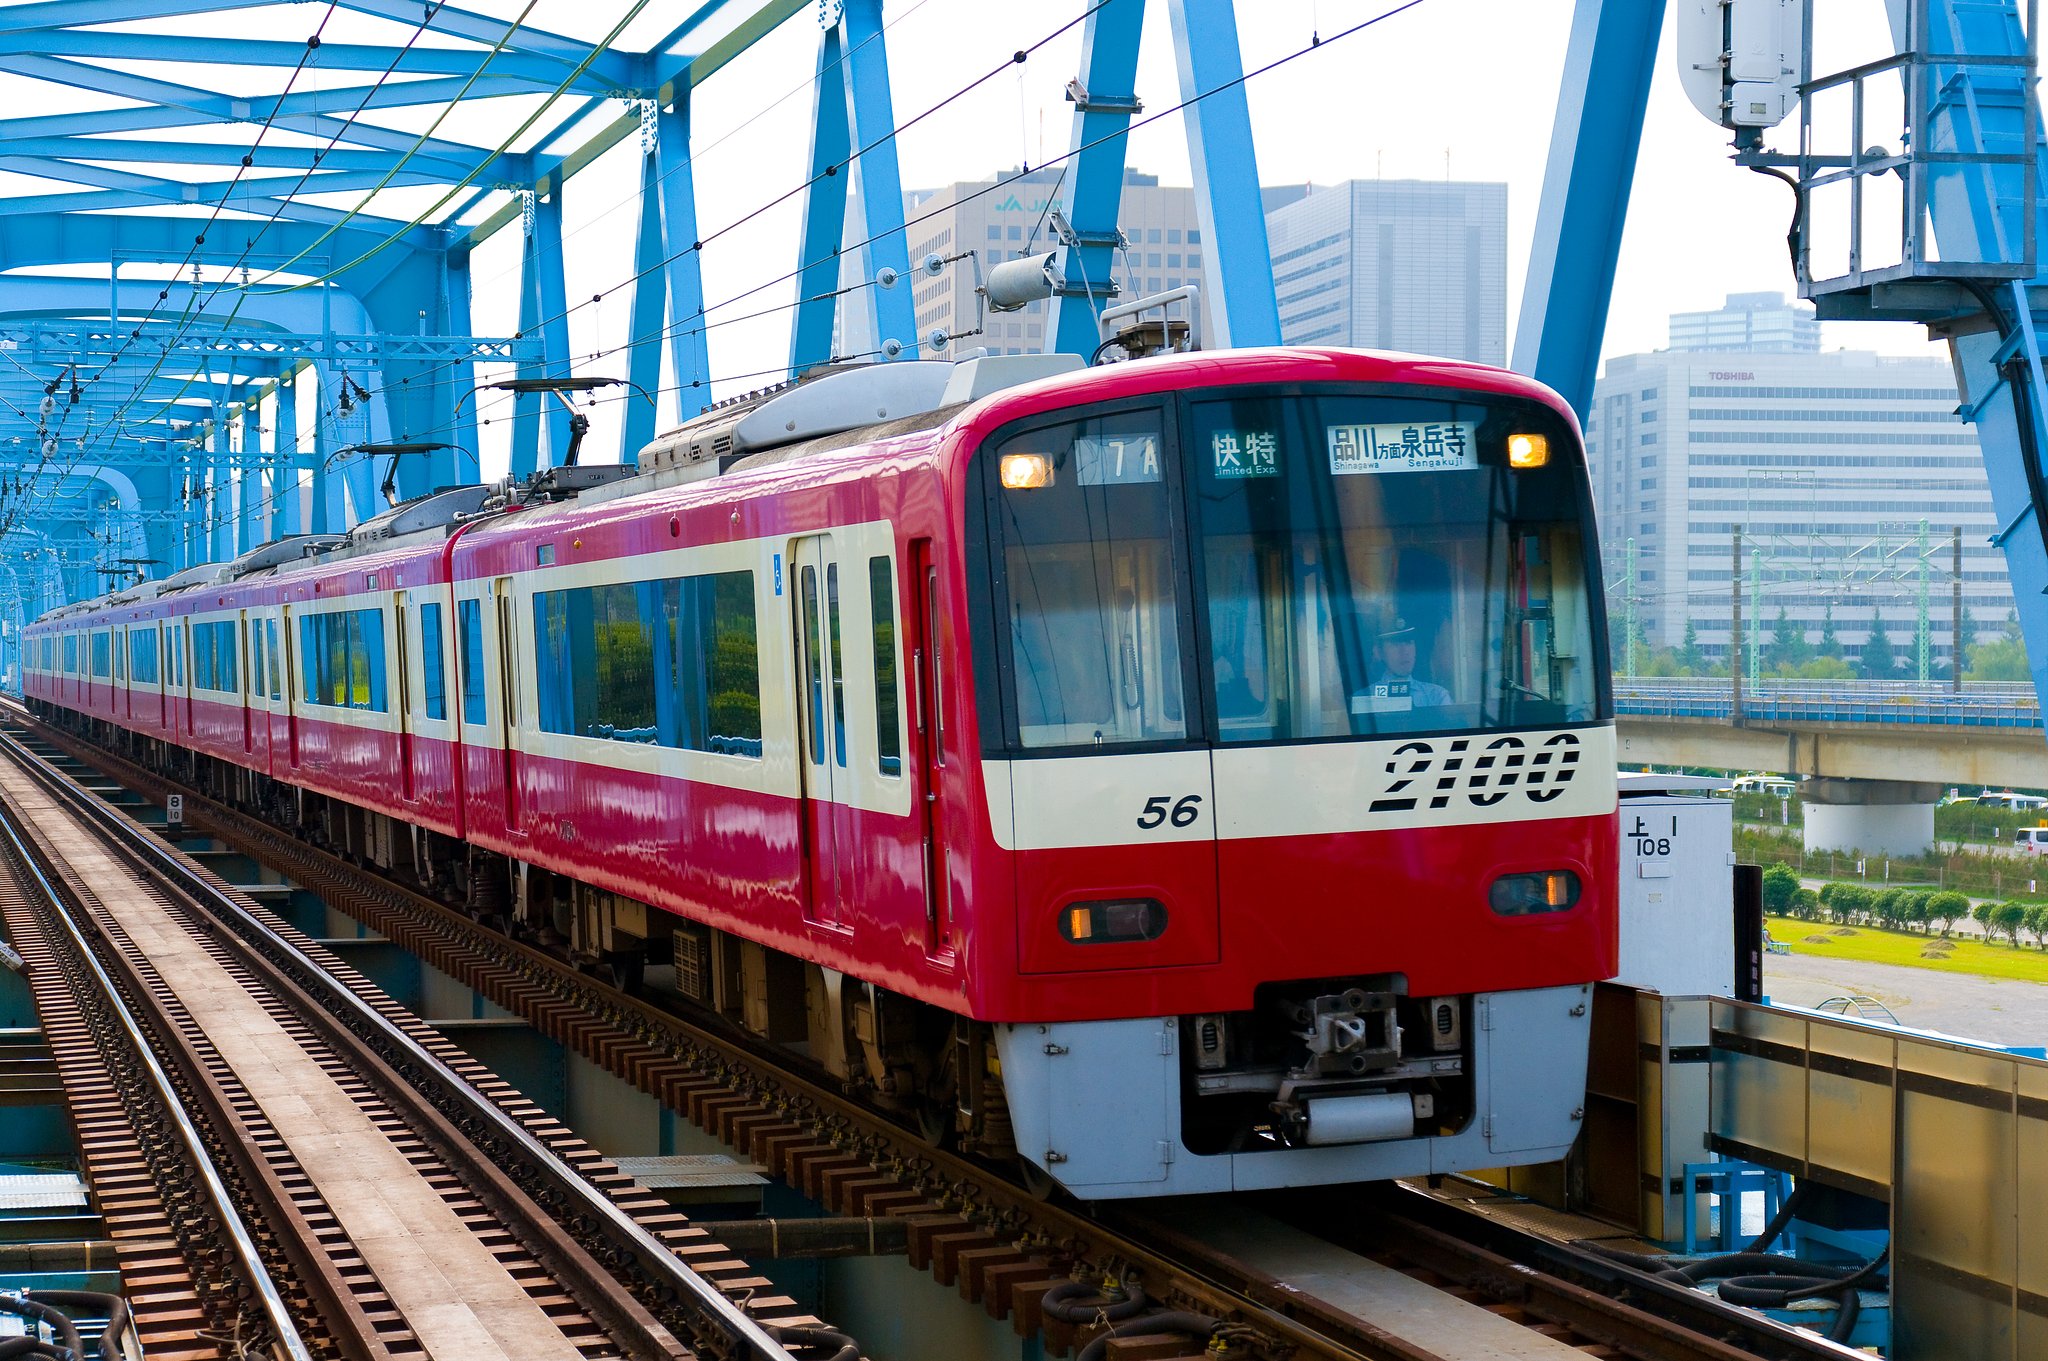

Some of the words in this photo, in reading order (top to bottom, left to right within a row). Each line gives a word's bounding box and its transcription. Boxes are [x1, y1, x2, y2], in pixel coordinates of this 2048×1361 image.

[1708, 371, 1755, 381] TOSHIBA
[1212, 431, 1276, 467] 快特
[1334, 461, 1380, 471] Shinagawa
[1408, 457, 1464, 468] Sengakuji
[1255, 465, 1278, 476] Exp.
[1376, 686, 1387, 697] 12
[1368, 733, 1581, 813] 2100
[170, 796, 179, 807] 8
[170, 811, 179, 819] 10
[1136, 795, 1203, 830] 56
[1627, 816, 1649, 837] 上
[1636, 838, 1671, 857] 108
